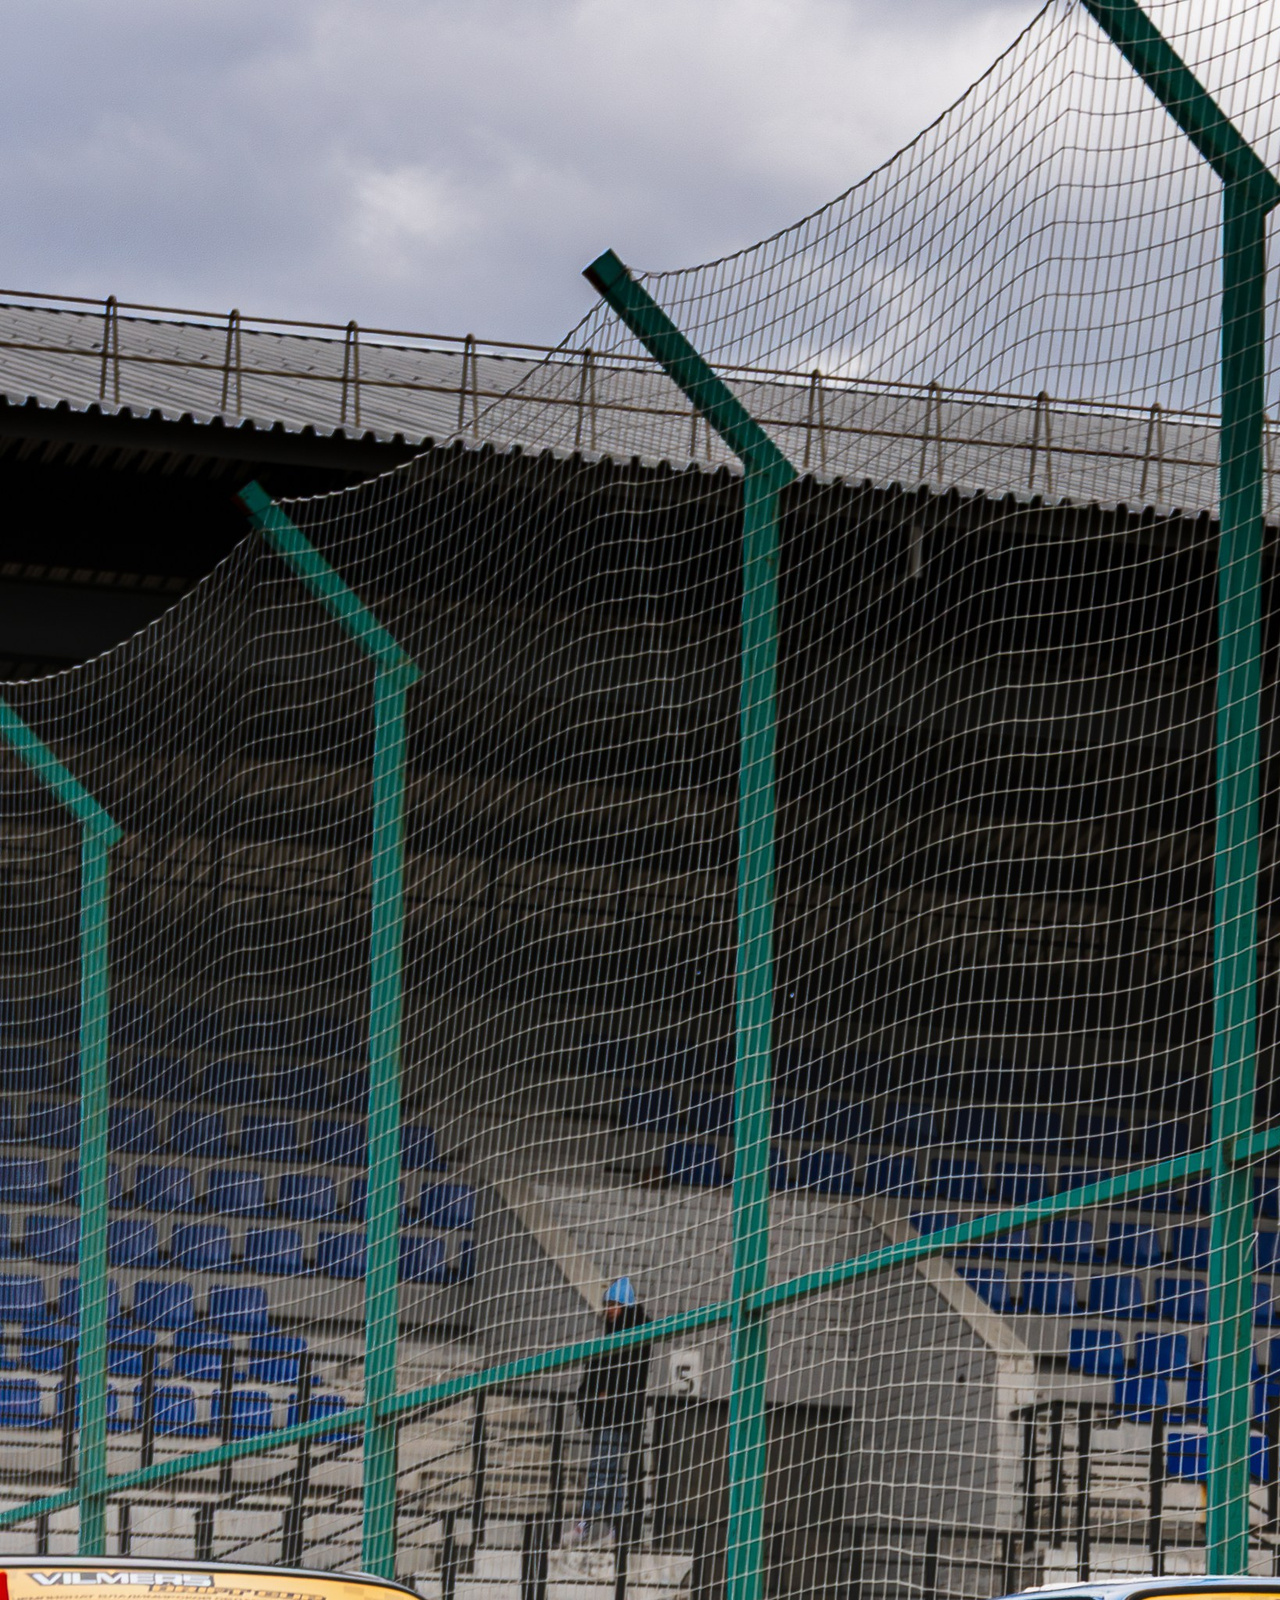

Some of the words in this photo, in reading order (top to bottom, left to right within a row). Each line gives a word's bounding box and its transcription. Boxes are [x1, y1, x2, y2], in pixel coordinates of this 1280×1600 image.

[676, 1365, 694, 1394] 5
[30, 1572, 213, 1587] VILMERS
[149, 1583, 251, 1596] DRIFT
